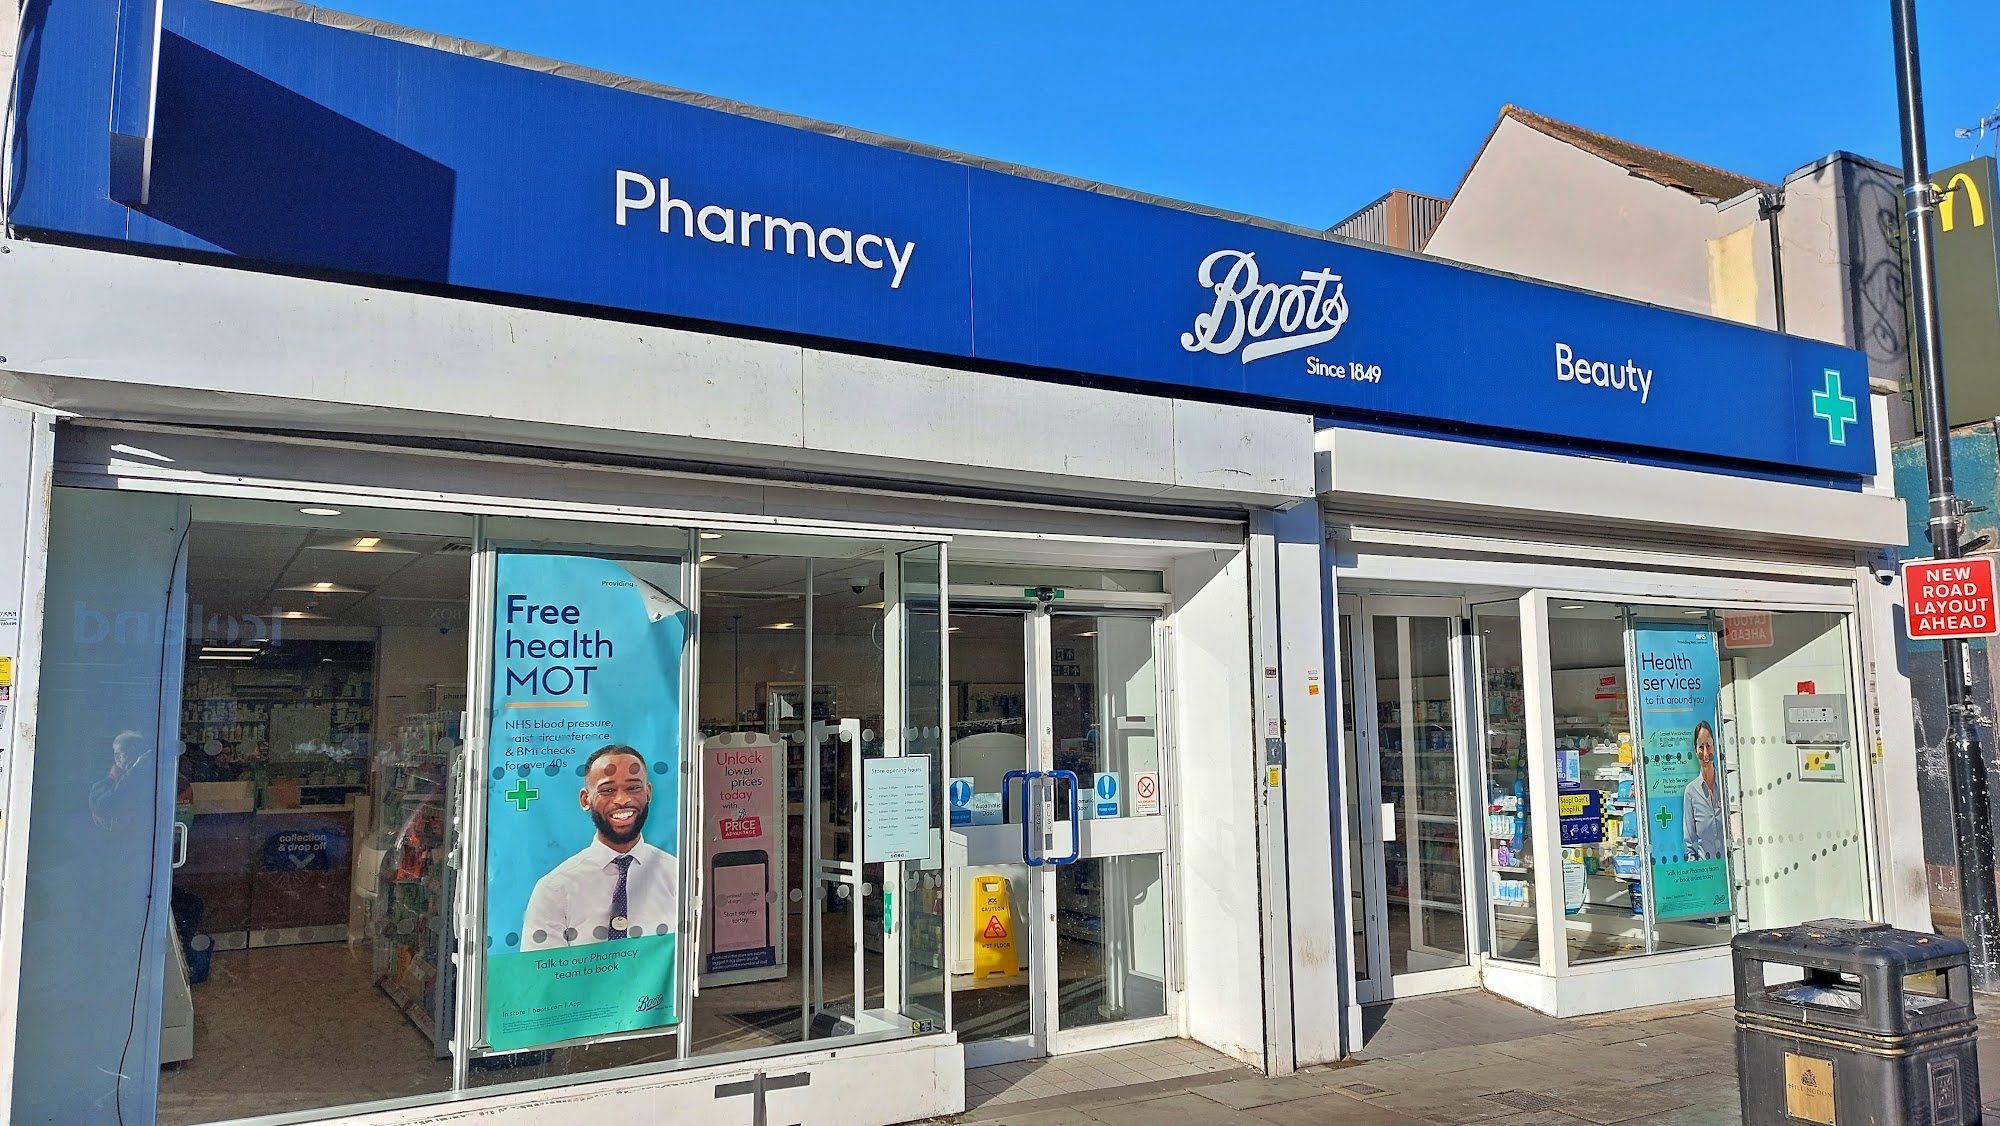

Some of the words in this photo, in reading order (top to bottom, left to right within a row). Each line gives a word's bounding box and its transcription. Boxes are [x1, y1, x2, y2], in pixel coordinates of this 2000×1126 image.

[616, 169, 915, 288] Pharmacy
[1181, 250, 1349, 365] Boots
[1307, 356, 1345, 378] Since
[1349, 362, 1382, 383] 1849
[1555, 343, 1652, 404] Beauty
[1926, 566, 1971, 582] NEW
[601, 580, 634, 588] Providing
[1922, 583, 1977, 598] ROAD
[507, 594, 580, 625] Free
[1914, 598, 1988, 615] LAYOUT
[1918, 615, 1987, 630] AHEAD
[505, 629, 613, 659] health
[1641, 652, 1692, 670] Health
[506, 665, 598, 696] MOT
[1643, 673, 1701, 690] services
[1645, 696, 1653, 704] to
[1656, 695, 1665, 704] fit
[1667, 695, 1692, 704] around
[505, 720, 531, 729] NHS
[534, 719, 564, 728] blood
[567, 720, 613, 730] pressure,
[506, 734, 533, 743] aist
[505, 748, 514, 756] &
[541, 746, 576, 755] checks
[716, 751, 762, 765] Unlock
[505, 761, 520, 770] for
[549, 758, 567, 768] 40s
[725, 766, 754, 776] lower
[731, 777, 762, 790] prices
[720, 789, 752, 802] today
[725, 820, 756, 831] PRICE
[279, 833, 326, 842] collection
[288, 842, 311, 851] drop
[313, 842, 327, 850] off
[1690, 867, 1708, 875] Pharmacy
[535, 958, 556, 969] Talk
[558, 958, 568, 967] to
[571, 957, 588, 965] our
[590, 949, 638, 963] Pharmacy
[554, 970, 581, 979] team
[583, 967, 593, 975] to
[595, 962, 619, 974] book
[532, 1004, 563, 1014] boots.com
[635, 993, 664, 1012] Boots
[1788, 1083, 1832, 1098] HILLINGDON
